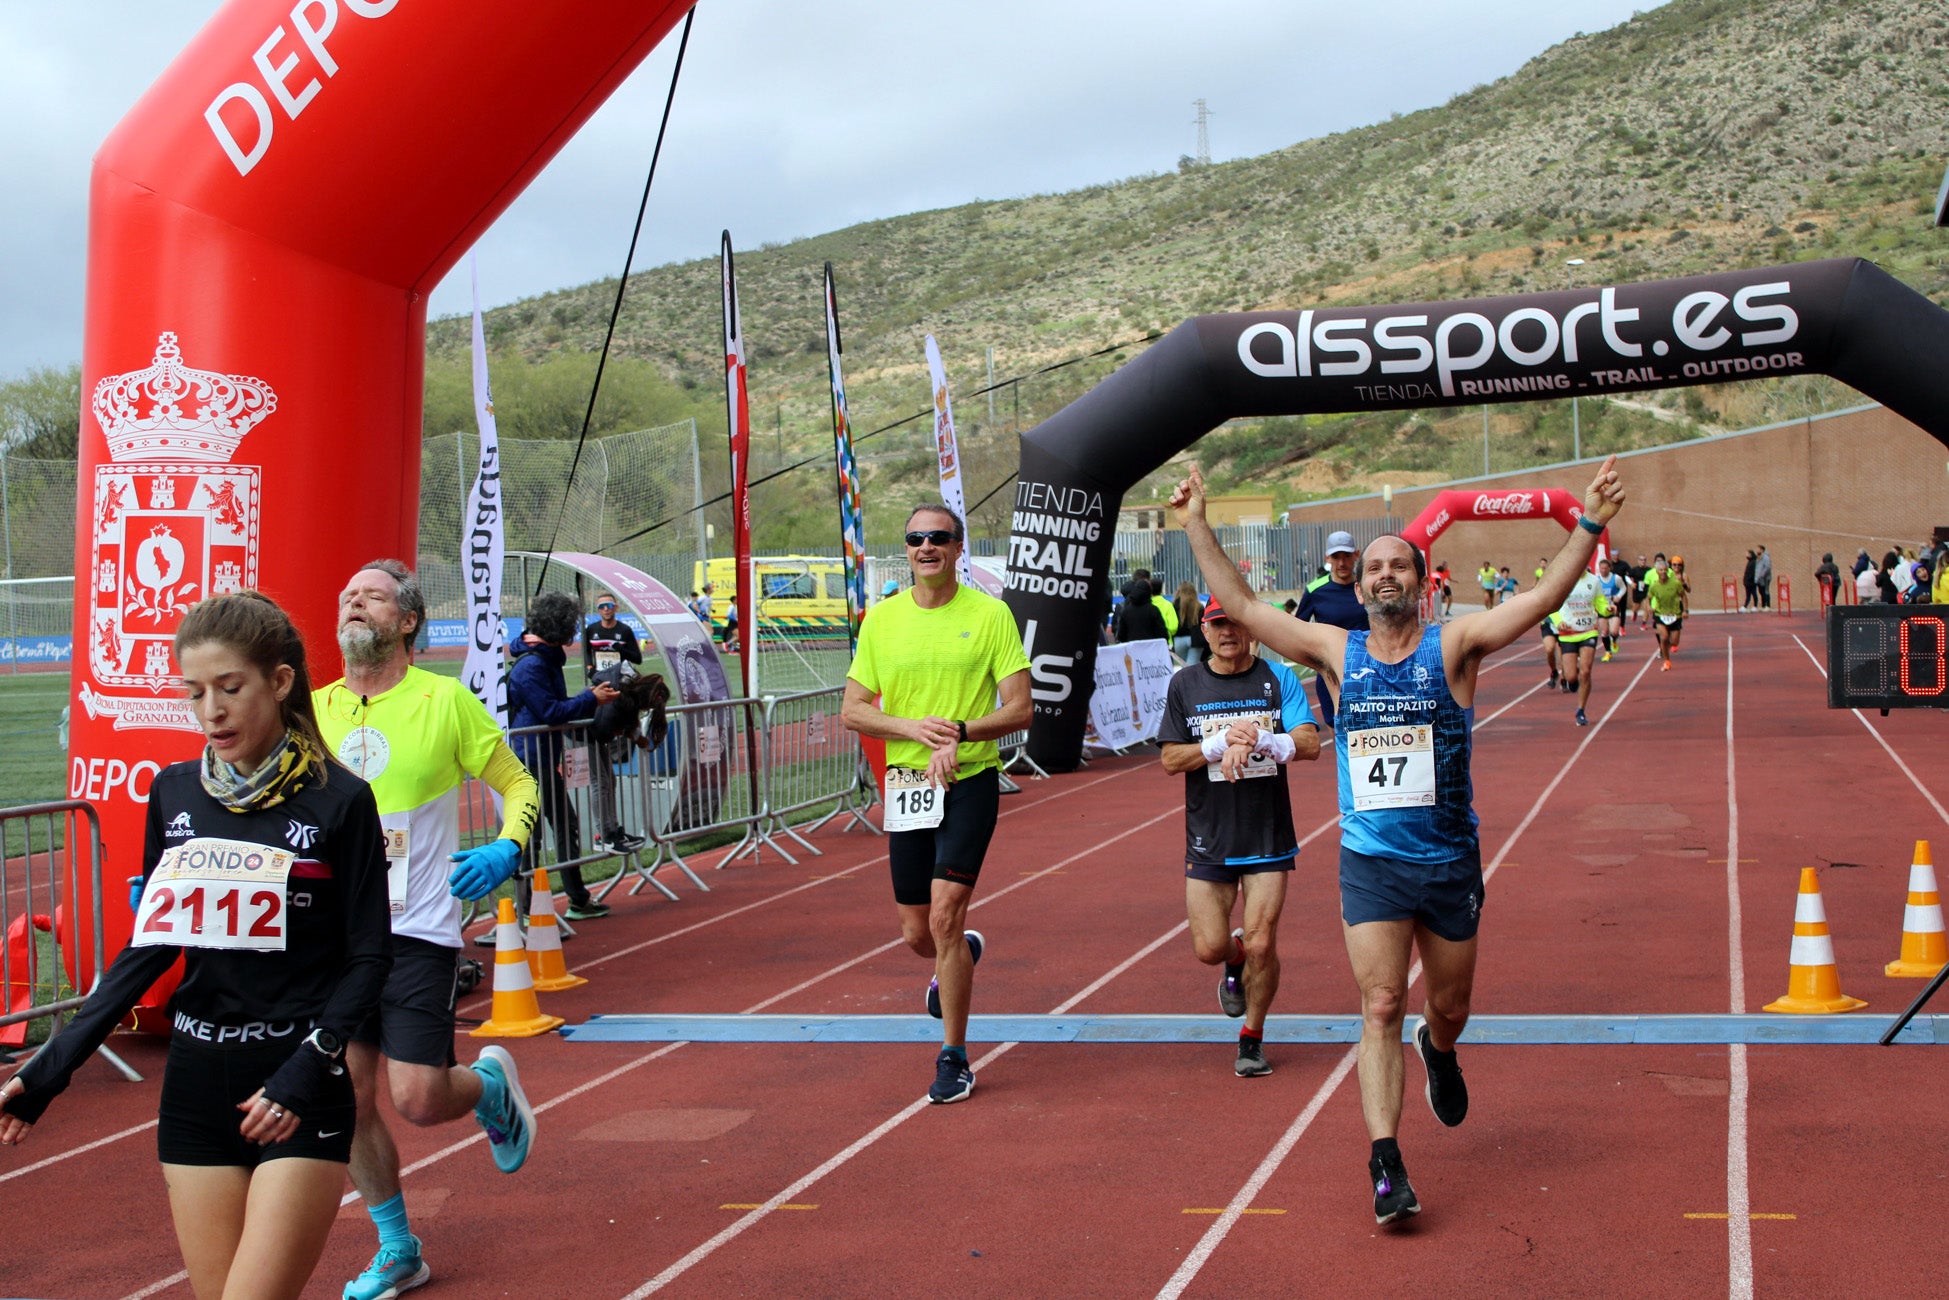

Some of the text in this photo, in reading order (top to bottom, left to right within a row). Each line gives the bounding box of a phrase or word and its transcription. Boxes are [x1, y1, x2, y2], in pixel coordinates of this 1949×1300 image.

[204, 0, 401, 177] DEP
[1237, 281, 1799, 397] alssport.es
[1354, 353, 1805, 401] TIENDA RUNNING TRAIL OUTDOOR
[1017, 481, 1103, 517] TIENDA
[1011, 511, 1101, 542] RUNNING
[1008, 535, 1093, 577] TRAIL
[1003, 570, 1089, 599] OUTDOOR
[117, 700, 164, 711] DIPUTACION
[123, 710, 190, 723] GRANADA
[1034, 705, 1063, 716] hop
[1195, 699, 1267, 712] TORREMOLINOS
[1349, 700, 1437, 713] PAZITO a PAZITO
[1379, 714, 1405, 723] Motril
[1362, 733, 1414, 749] FONDO
[1368, 756, 1408, 787] 47
[896, 789, 935, 815] 189
[177, 850, 264, 871] FONDO
[211, 843, 249, 853] PREMIO
[143, 887, 283, 937] 2112
[174, 1010, 296, 1043] NIKE PRO
